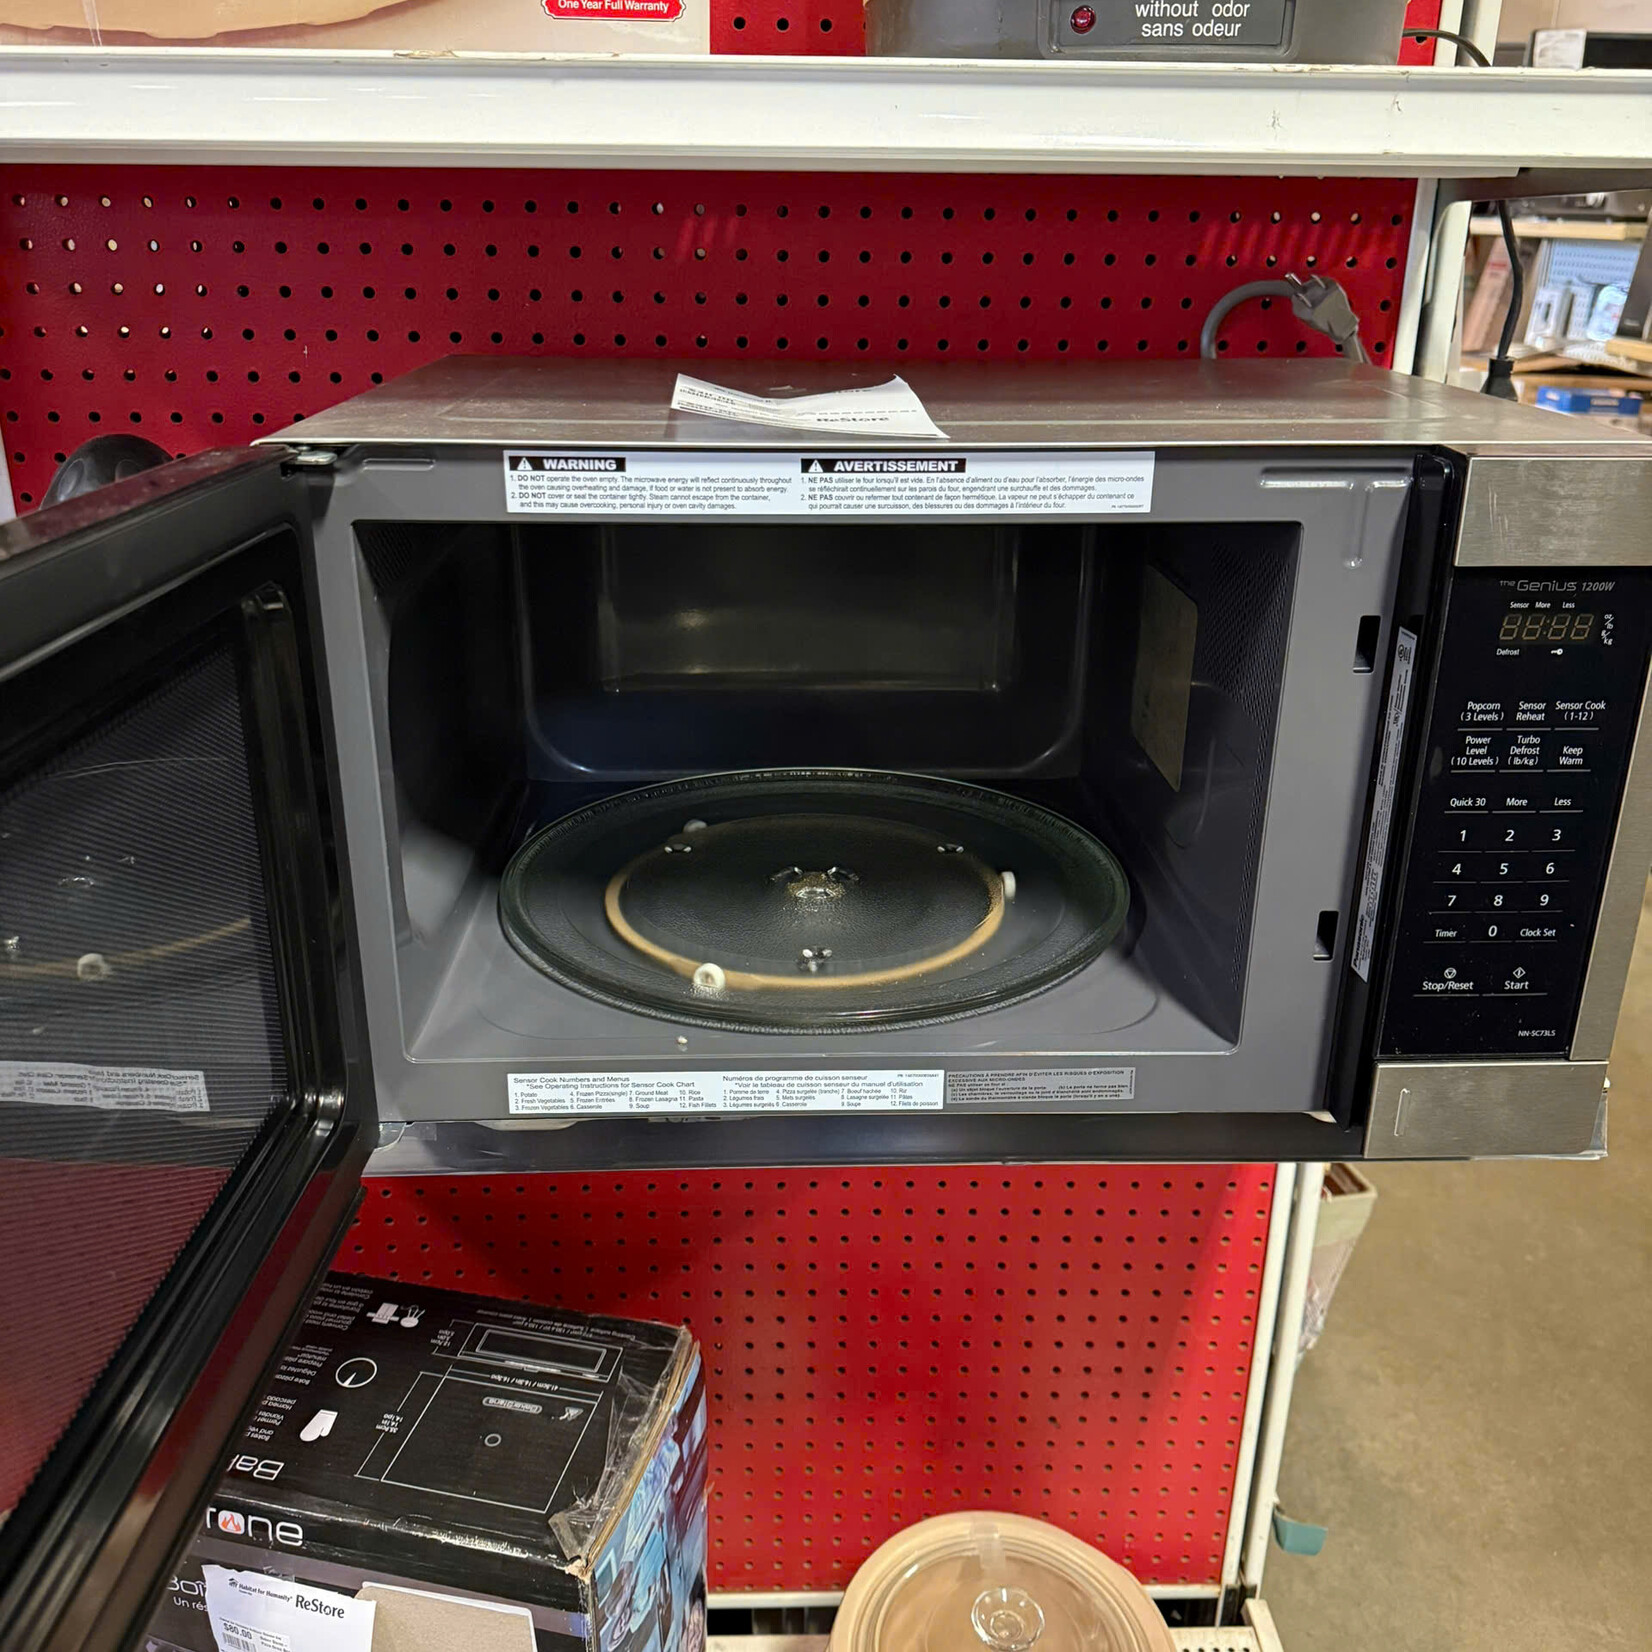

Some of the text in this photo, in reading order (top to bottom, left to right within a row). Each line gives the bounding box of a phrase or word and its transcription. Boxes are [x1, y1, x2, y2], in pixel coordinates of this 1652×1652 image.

[558, 0, 669, 13] One Year Full Warranty
[1135, 0, 1250, 17] without odor
[1142, 19, 1242, 37] sans odeur
[543, 459, 617, 470] WARNING
[834, 460, 958, 472] AVERTISSEMENT
[546, 475, 570, 484] operate
[667, 477, 689, 485] energy
[720, 476, 758, 485] continuously
[759, 477, 792, 485] throughout
[546, 484, 570, 492] causing
[571, 484, 608, 493] overheating
[713, 485, 736, 494] present
[619, 502, 646, 511] personal
[646, 502, 664, 511] injury
[688, 503, 706, 511] cavity
[1516, 580, 1578, 592] Genius
[1582, 582, 1616, 592] 1200W
[1496, 648, 1520, 656] Defrost
[1468, 701, 1500, 711] Popcorn
[1518, 701, 1546, 710] Sensor
[1555, 701, 1606, 710] Sensor Cook
[1516, 712, 1546, 721] Reheat
[1465, 736, 1492, 745] Power
[1517, 736, 1540, 744] Turbo
[1466, 746, 1488, 755] Level
[1510, 746, 1540, 755] Defrost
[1562, 746, 1583, 756] Keep
[1559, 757, 1583, 766] Warm
[1450, 798, 1486, 807] Quick 30
[1506, 798, 1528, 806] More
[1554, 797, 1572, 806] Less
[1460, 830, 1466, 842] 1
[1504, 830, 1515, 842] 2
[1552, 829, 1562, 841] 3
[1452, 863, 1462, 875] 4
[1500, 863, 1509, 875] 5
[1546, 862, 1555, 874] 6
[1448, 895, 1457, 906] 7
[1494, 894, 1504, 906] 8
[1540, 894, 1550, 906] 9
[1435, 928, 1458, 937] Timer
[1488, 926, 1498, 937] 0
[1520, 928, 1556, 937] Clock Set
[1422, 980, 1474, 991] Stop/Reset
[1504, 980, 1529, 990] Start
[544, 1083, 579, 1091] Operating
[238, 1584, 258, 1593] Habitat
[296, 1594, 345, 1618] ReStore
[223, 1622, 253, 1640] $80.00
